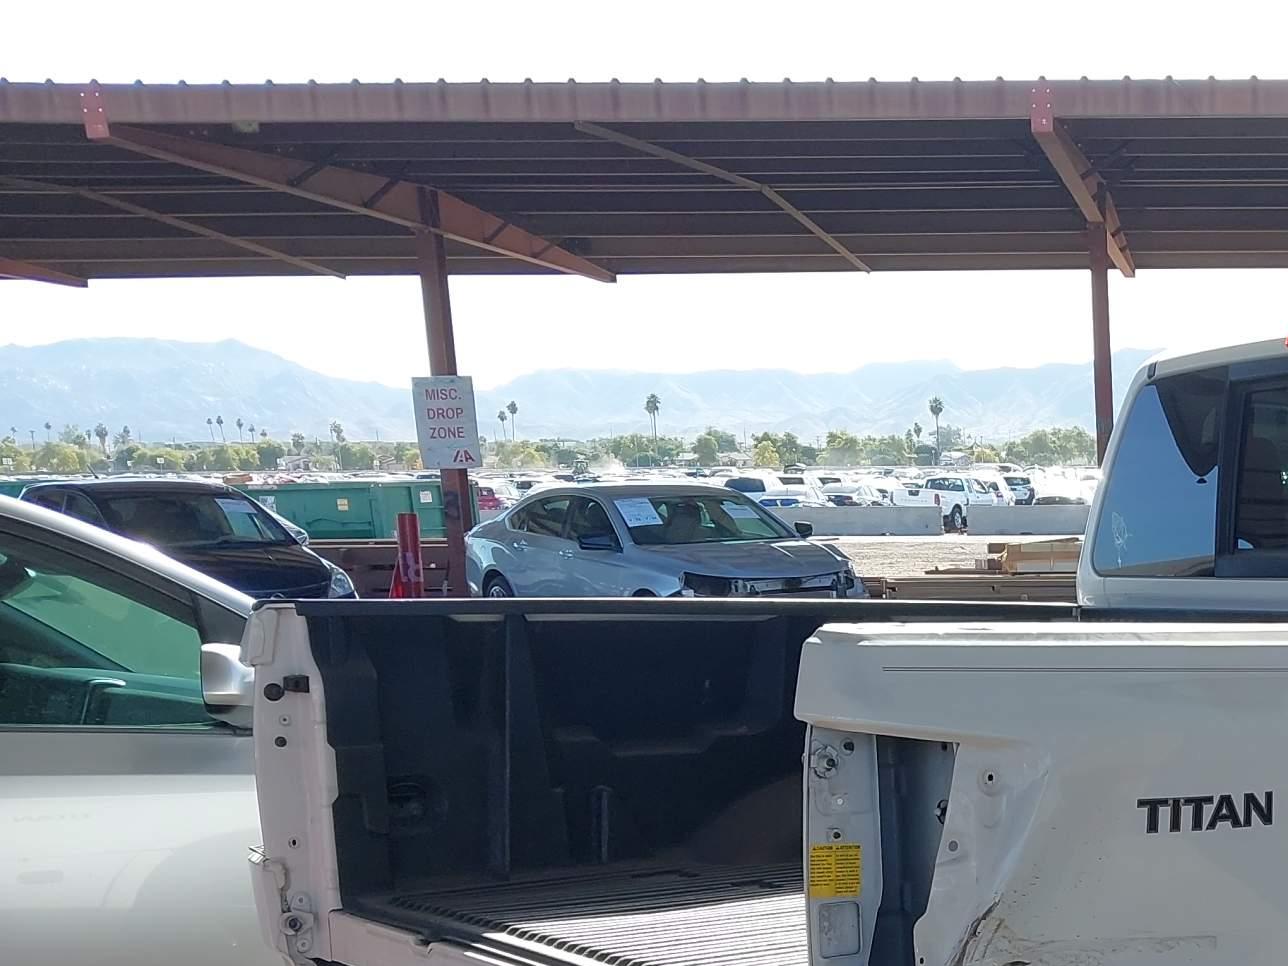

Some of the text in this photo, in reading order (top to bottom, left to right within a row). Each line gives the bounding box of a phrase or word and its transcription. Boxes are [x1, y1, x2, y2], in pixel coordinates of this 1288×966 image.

[425, 388, 462, 400] MISC.
[427, 408, 464, 420] DROP
[430, 427, 465, 439] ZONE
[1136, 791, 1274, 834] TITAN
